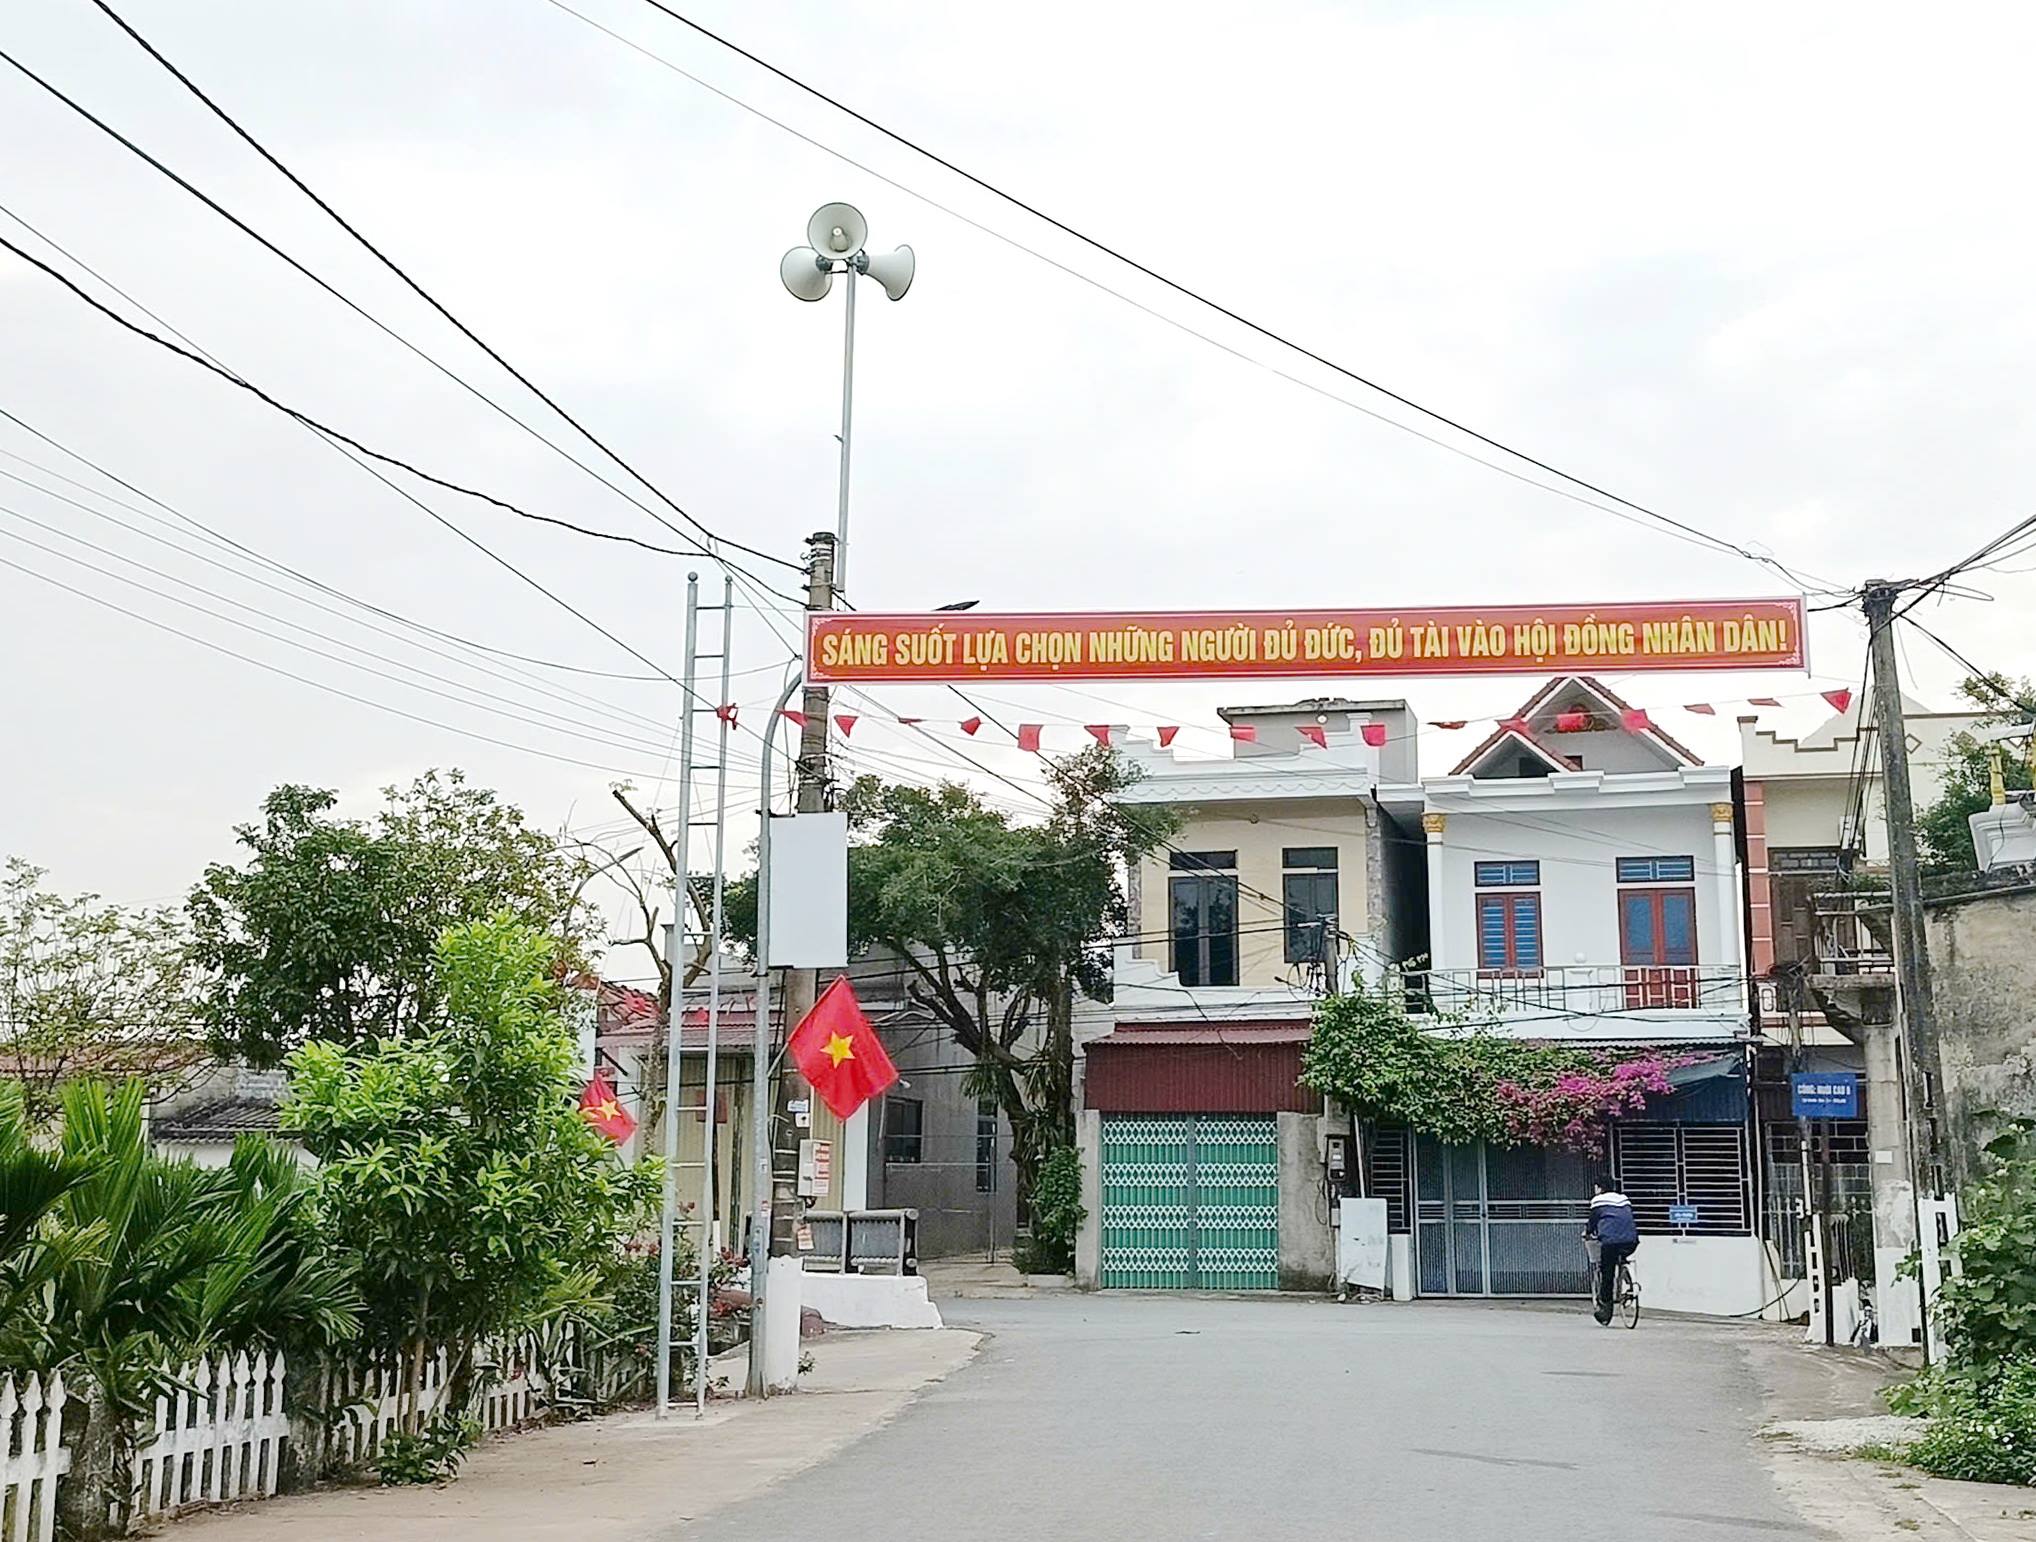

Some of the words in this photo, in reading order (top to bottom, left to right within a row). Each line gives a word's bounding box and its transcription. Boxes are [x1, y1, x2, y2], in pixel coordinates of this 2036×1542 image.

[822, 628, 888, 666] SÁNG
[894, 622, 957, 665] SUỐT
[963, 629, 1009, 671] LỰA
[1015, 632, 1082, 670] CHỌN
[1089, 625, 1174, 663] NHỮNG
[1181, 622, 1256, 661] NGƯỜI
[1263, 619, 1297, 660] ĐỦ
[1304, 622, 1363, 663] ĐỨC,
[1369, 617, 1403, 659] ĐỦ
[1409, 619, 1449, 658] TÀI
[1456, 618, 1506, 657] VÀO
[1513, 617, 1557, 663] HỘI
[1563, 613, 1635, 656] ĐỒNG
[1642, 615, 1716, 654] NHÂN
[1723, 613, 1788, 652] DÂN!
